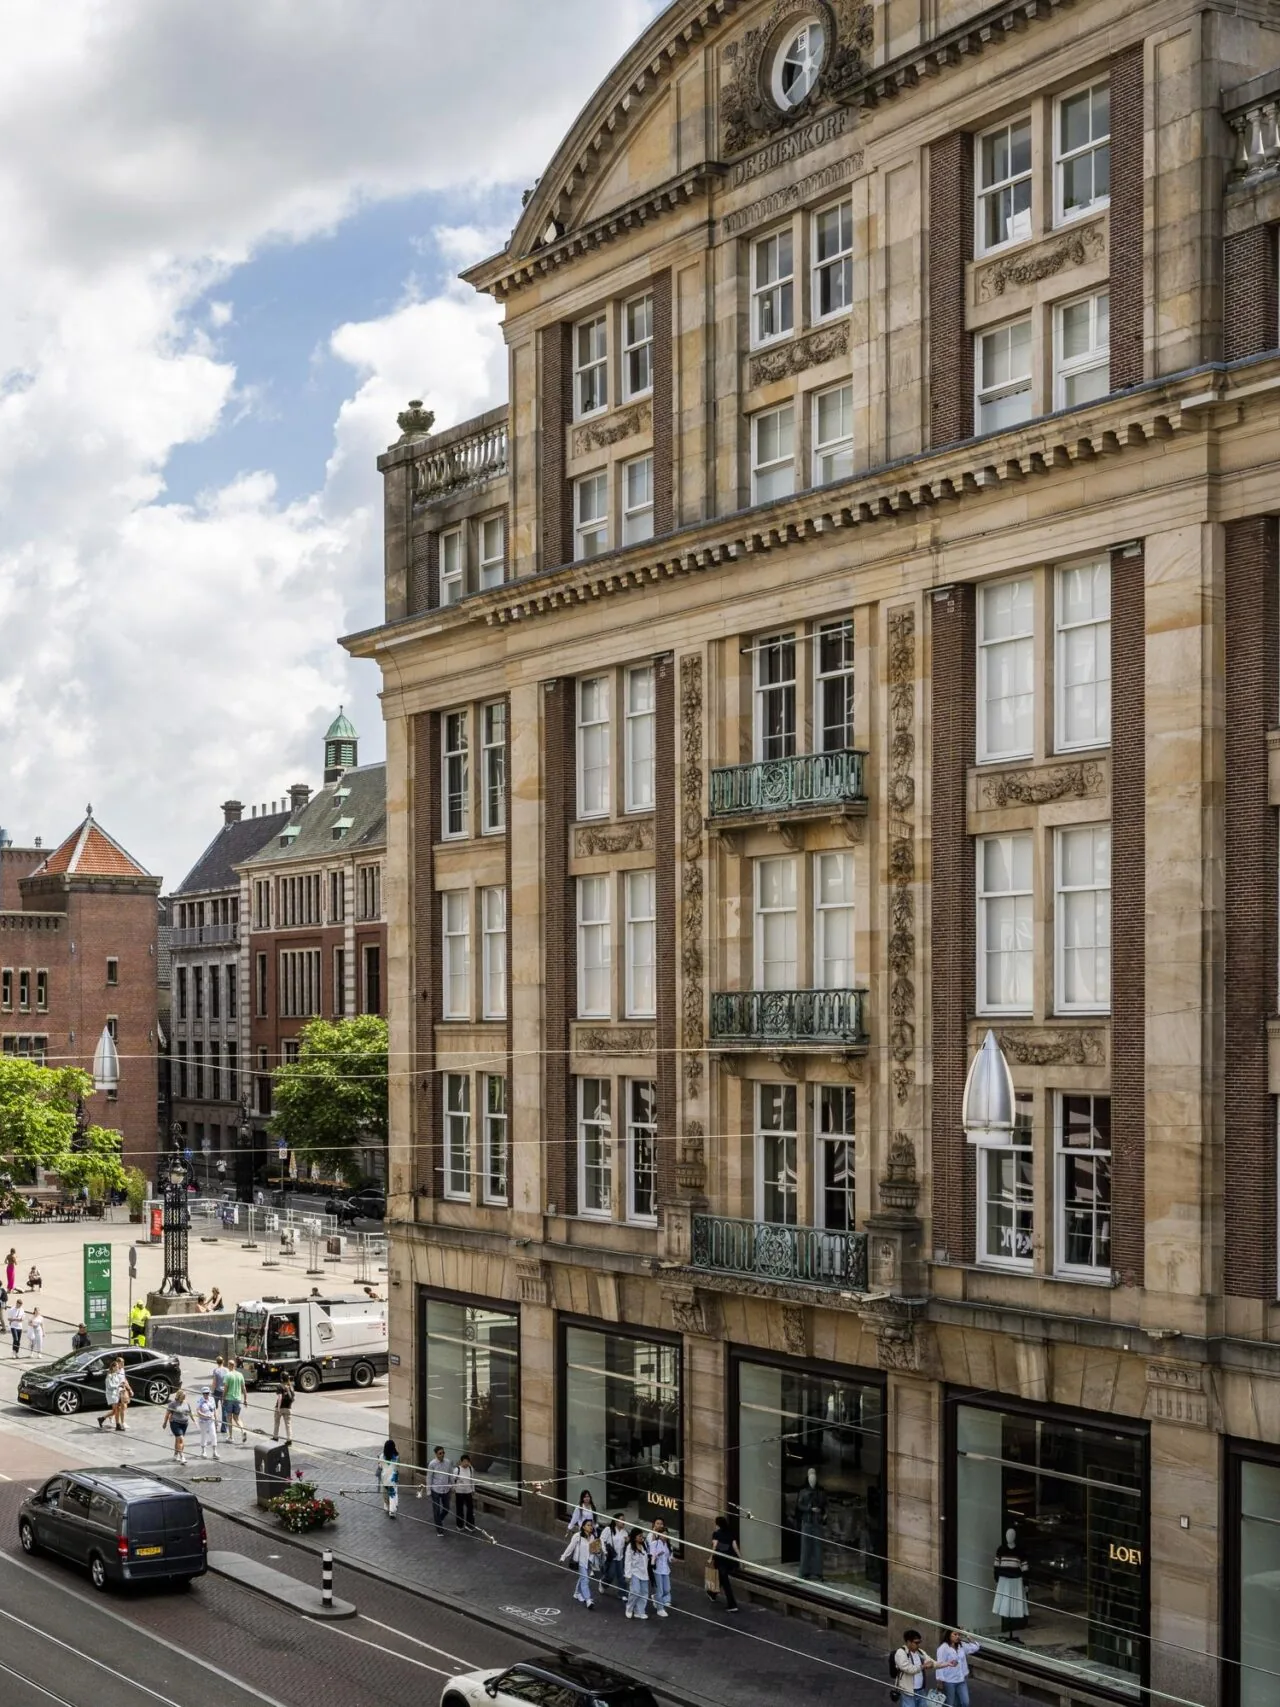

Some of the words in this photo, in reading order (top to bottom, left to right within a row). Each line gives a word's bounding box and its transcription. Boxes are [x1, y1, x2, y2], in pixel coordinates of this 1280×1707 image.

[88, 1247, 95, 1258] P
[647, 1490, 679, 1511] LOEWE
[1110, 1543, 1141, 1566] LOE
